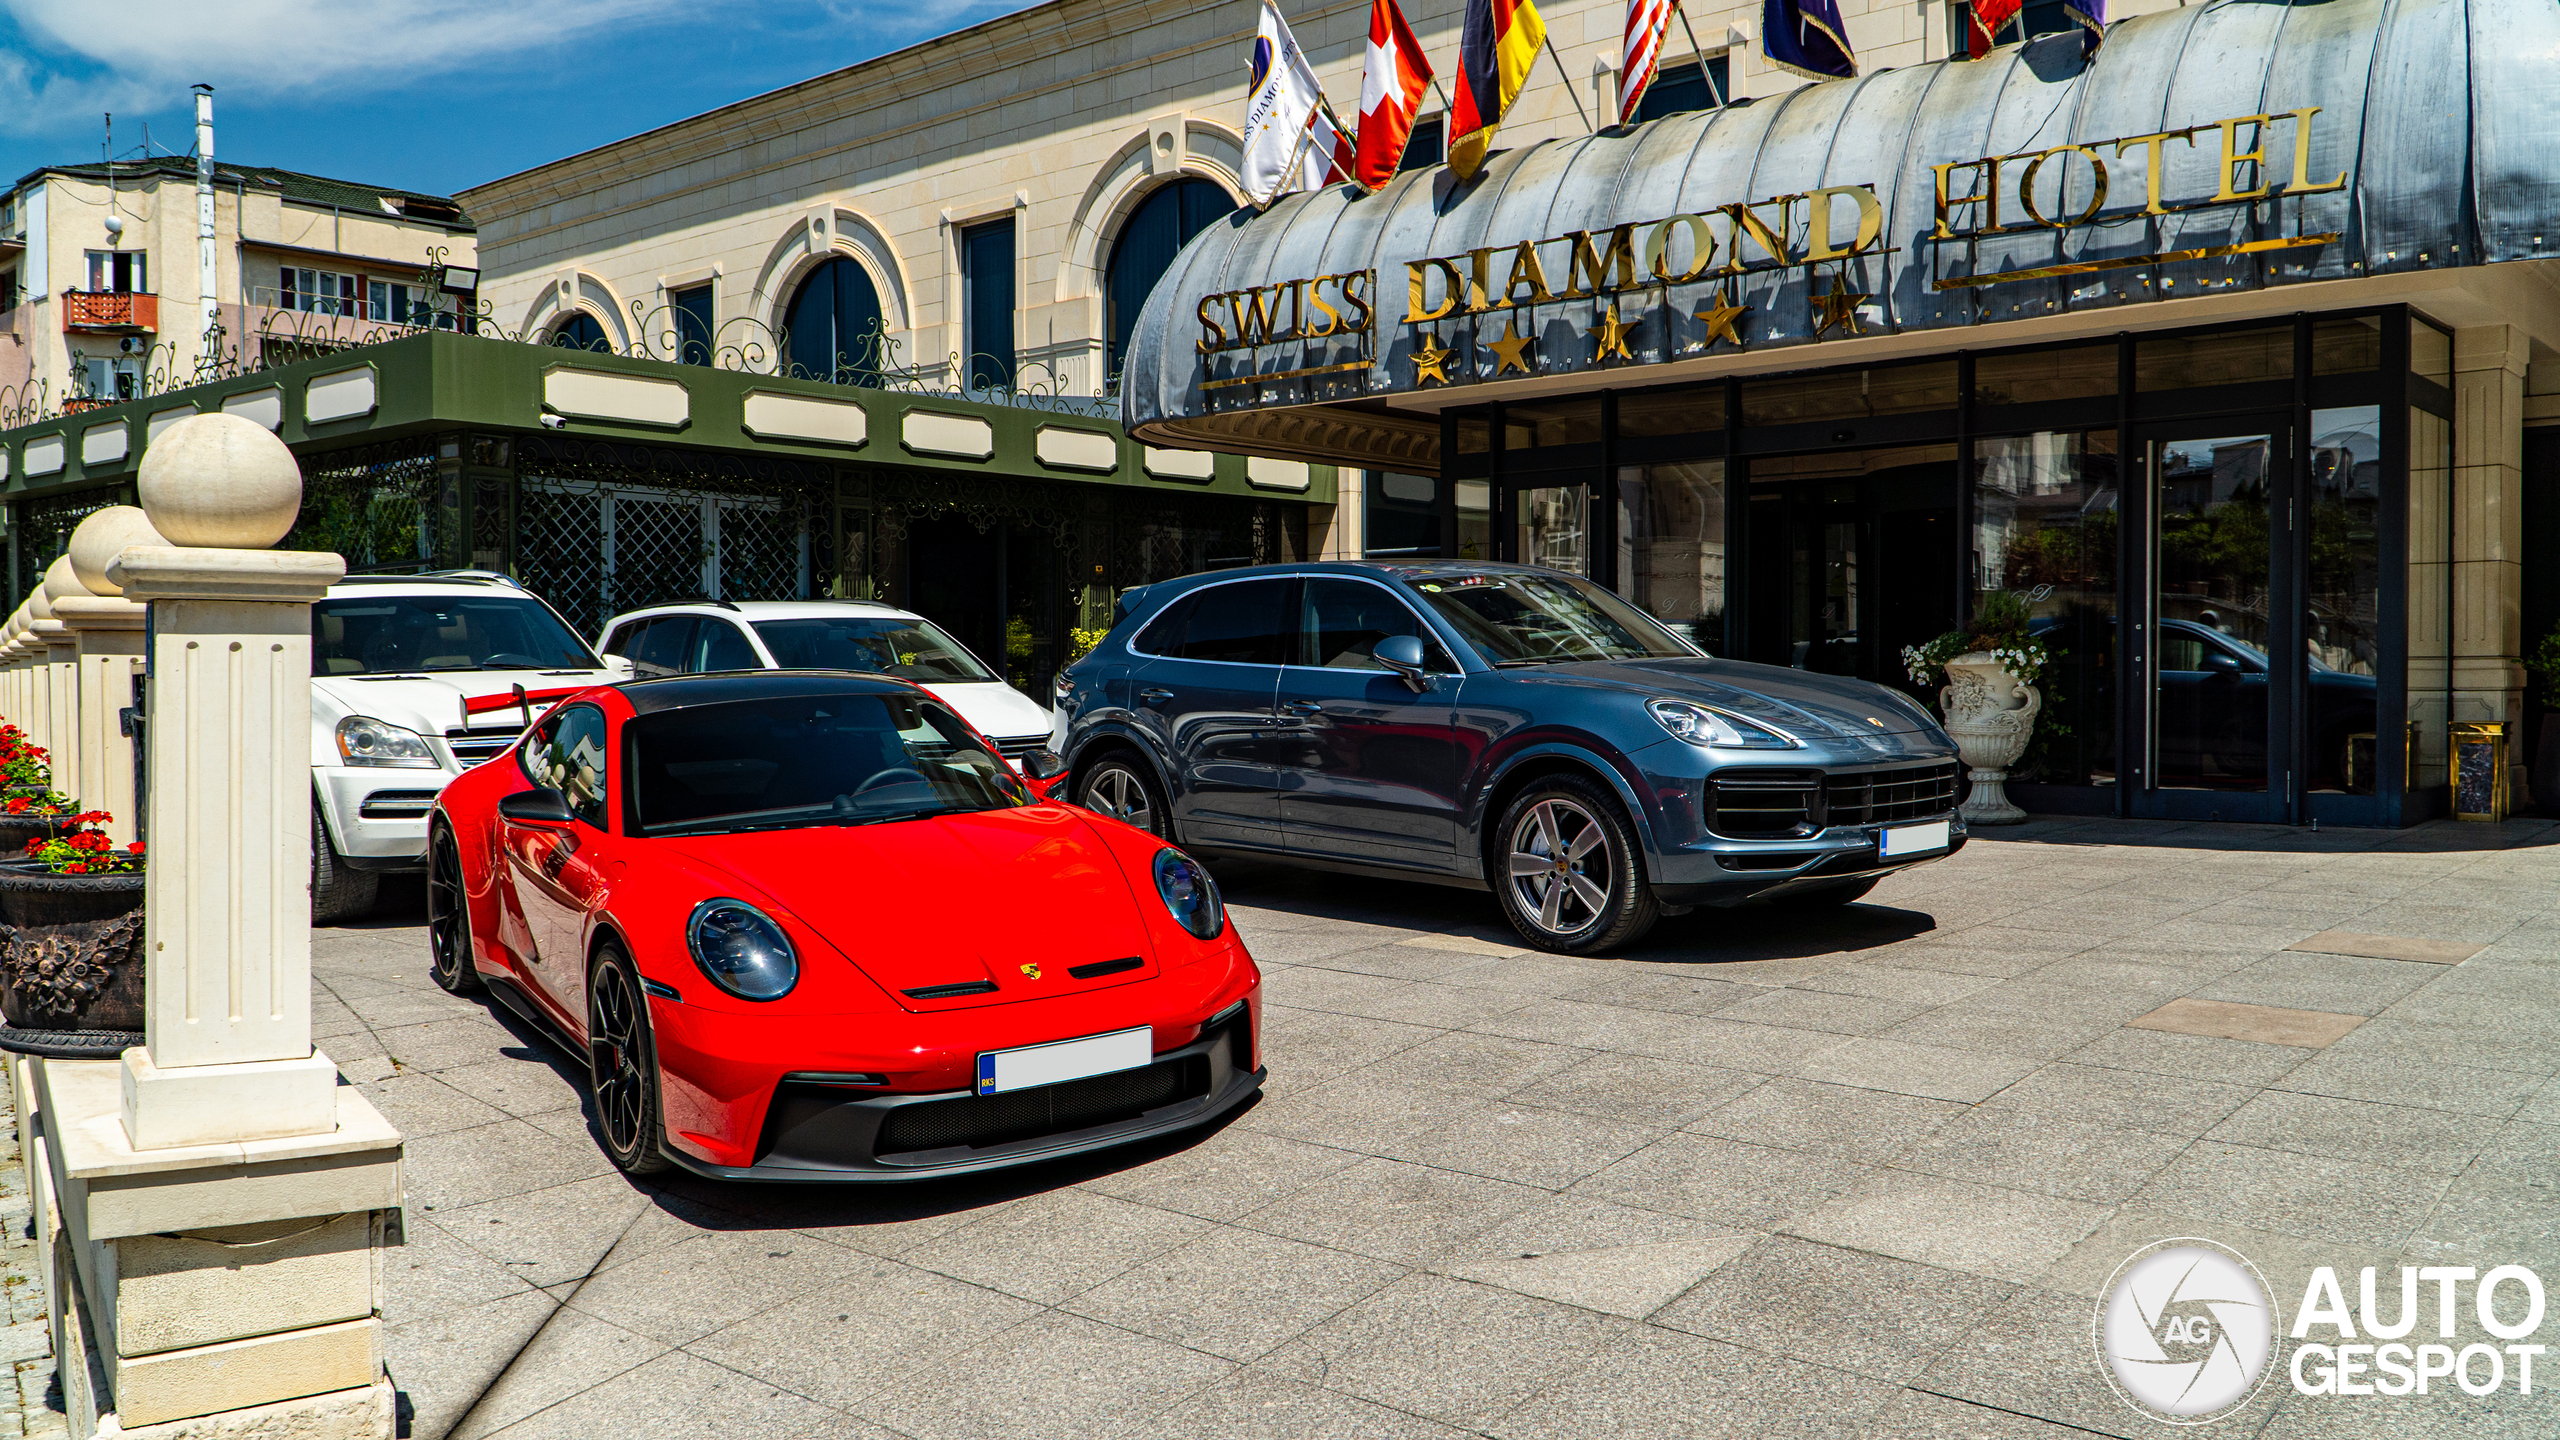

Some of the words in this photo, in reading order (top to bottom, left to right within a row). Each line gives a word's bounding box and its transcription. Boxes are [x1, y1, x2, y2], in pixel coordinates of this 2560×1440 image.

[1196, 269, 1374, 355] SWISS
[1402, 185, 1884, 324] DIAMOND
[1928, 106, 2348, 241] HOTEL
[982, 1078, 994, 1087] RKS
